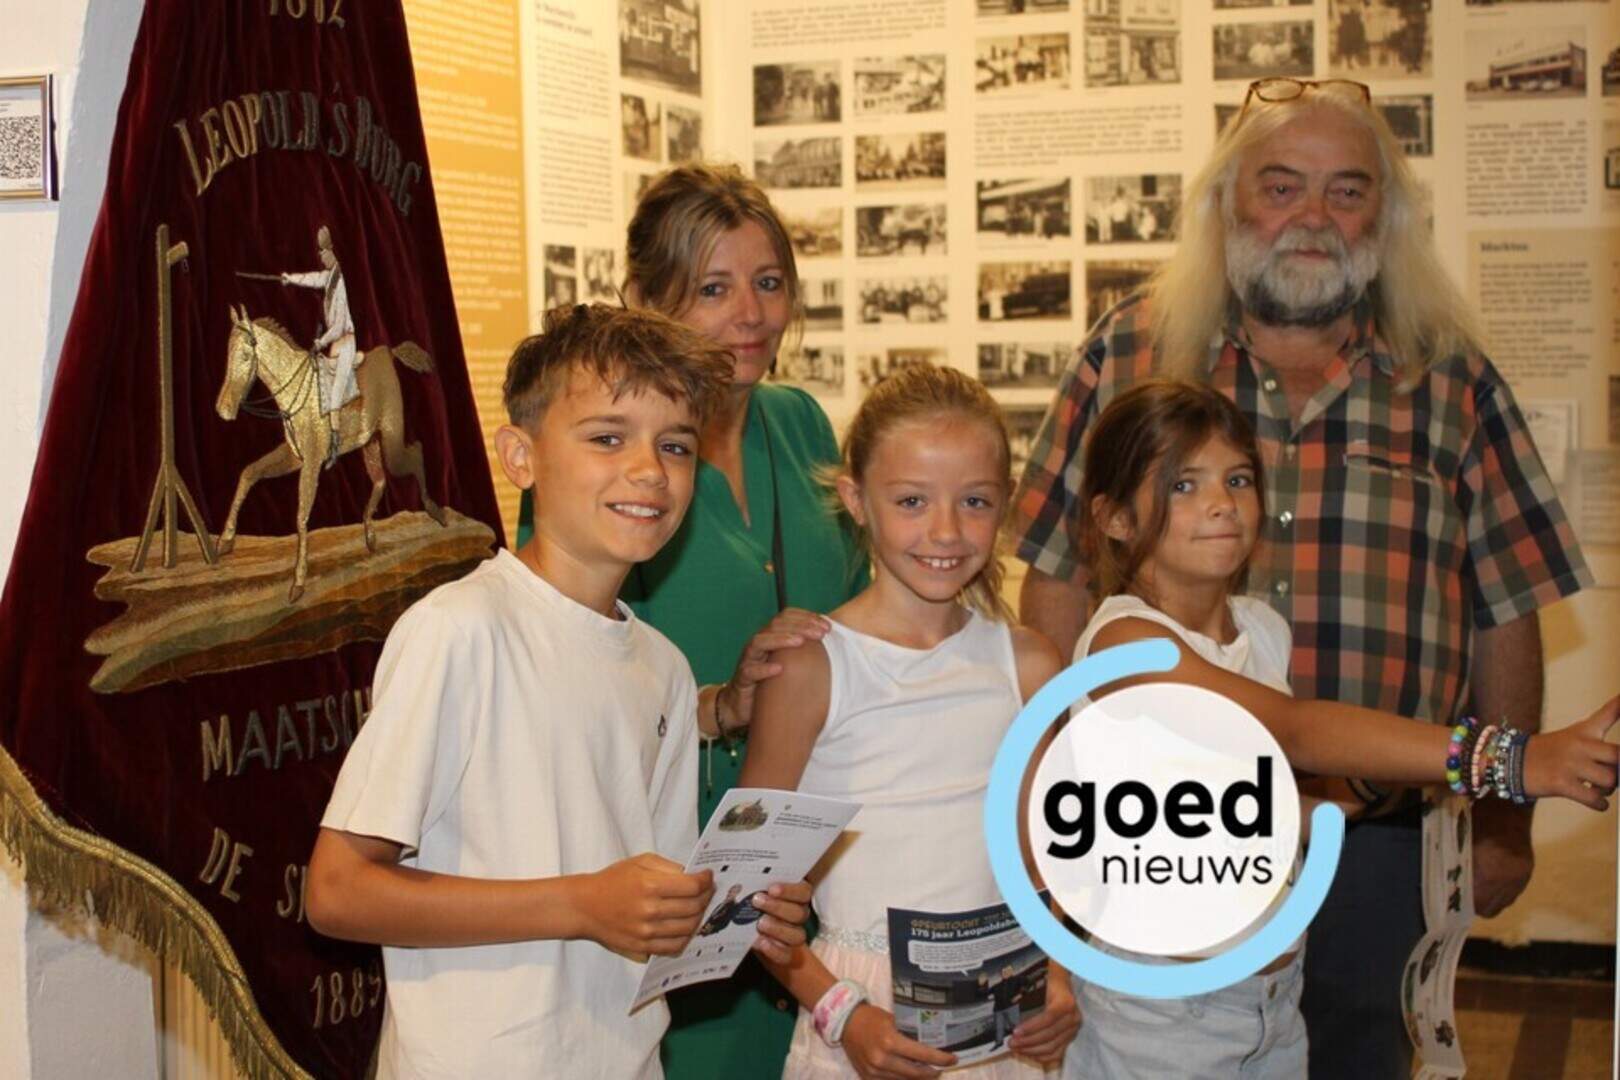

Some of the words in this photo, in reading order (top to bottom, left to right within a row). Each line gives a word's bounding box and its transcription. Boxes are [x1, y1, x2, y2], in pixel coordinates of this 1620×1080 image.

[199, 826, 255, 904] DE
[911, 927, 930, 938] 175
[932, 929, 954, 940] jaar
